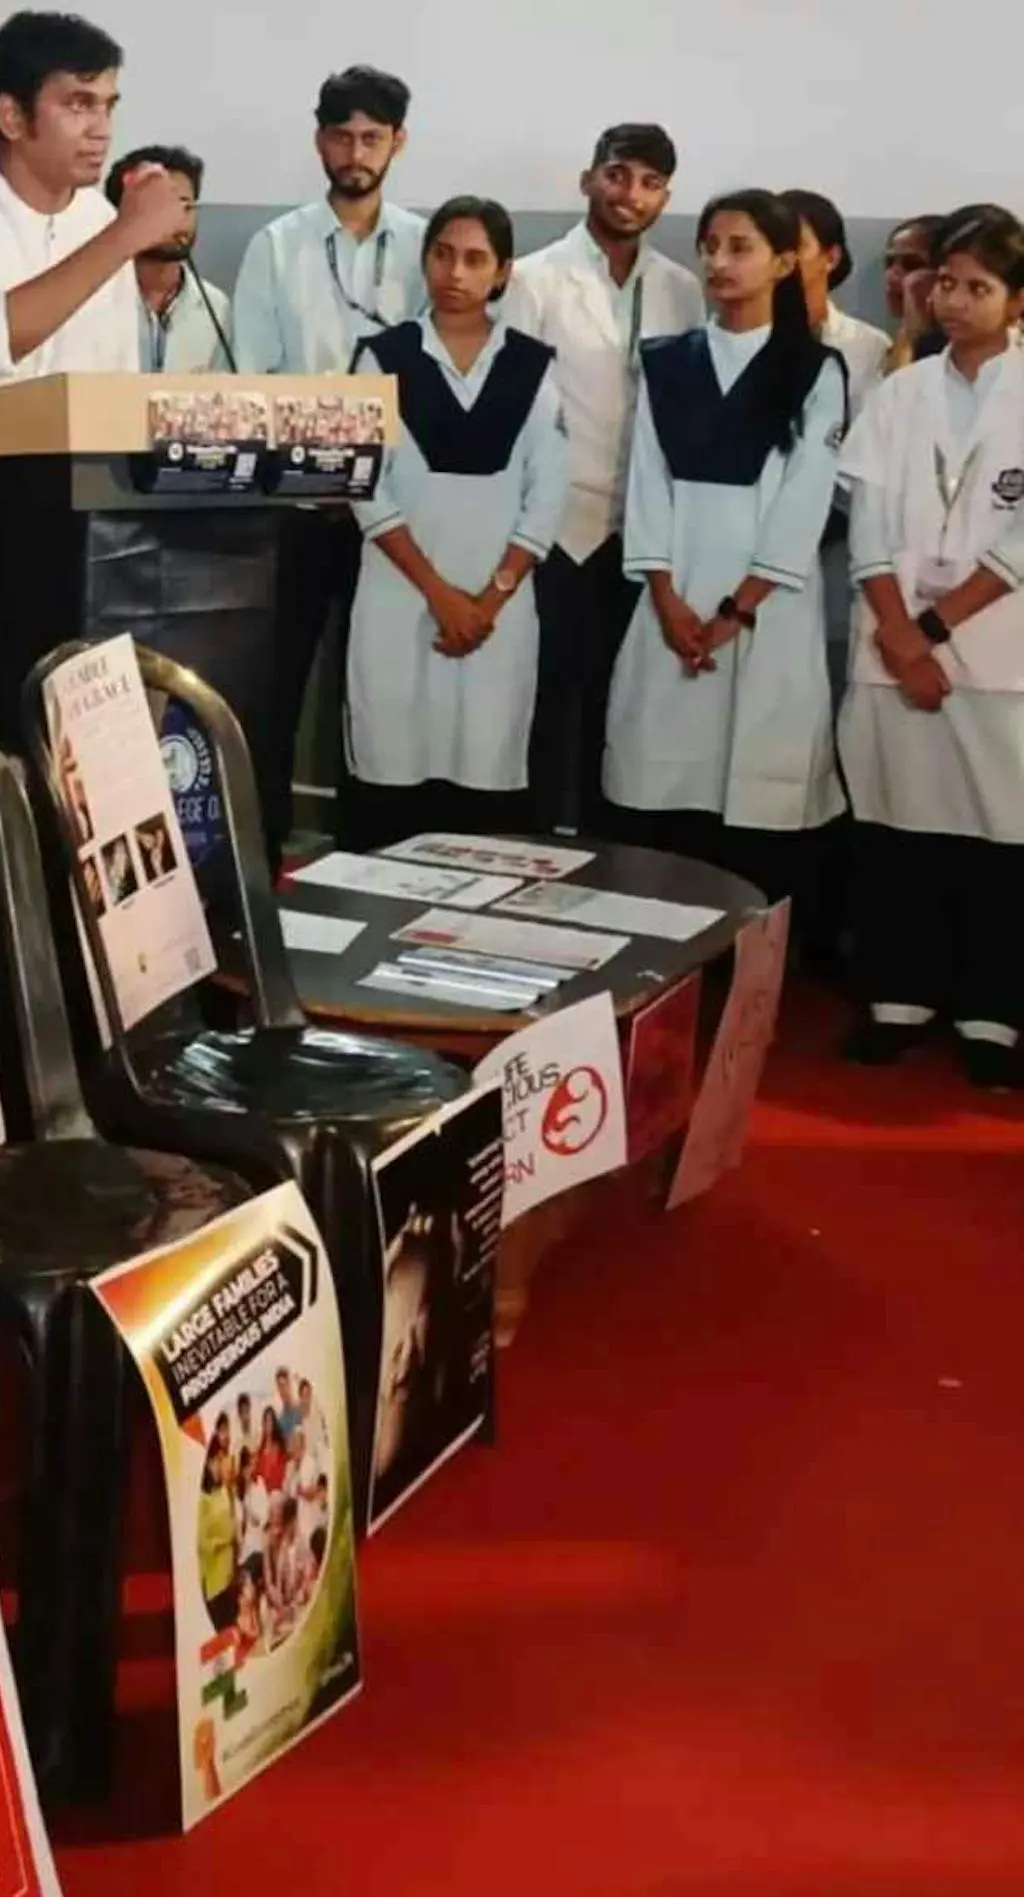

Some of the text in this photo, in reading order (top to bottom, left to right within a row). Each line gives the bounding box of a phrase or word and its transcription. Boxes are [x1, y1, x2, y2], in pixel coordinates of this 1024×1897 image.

[161, 1249, 280, 1362] LARGE FAMILIES
[249, 1281, 277, 1318] FOR
